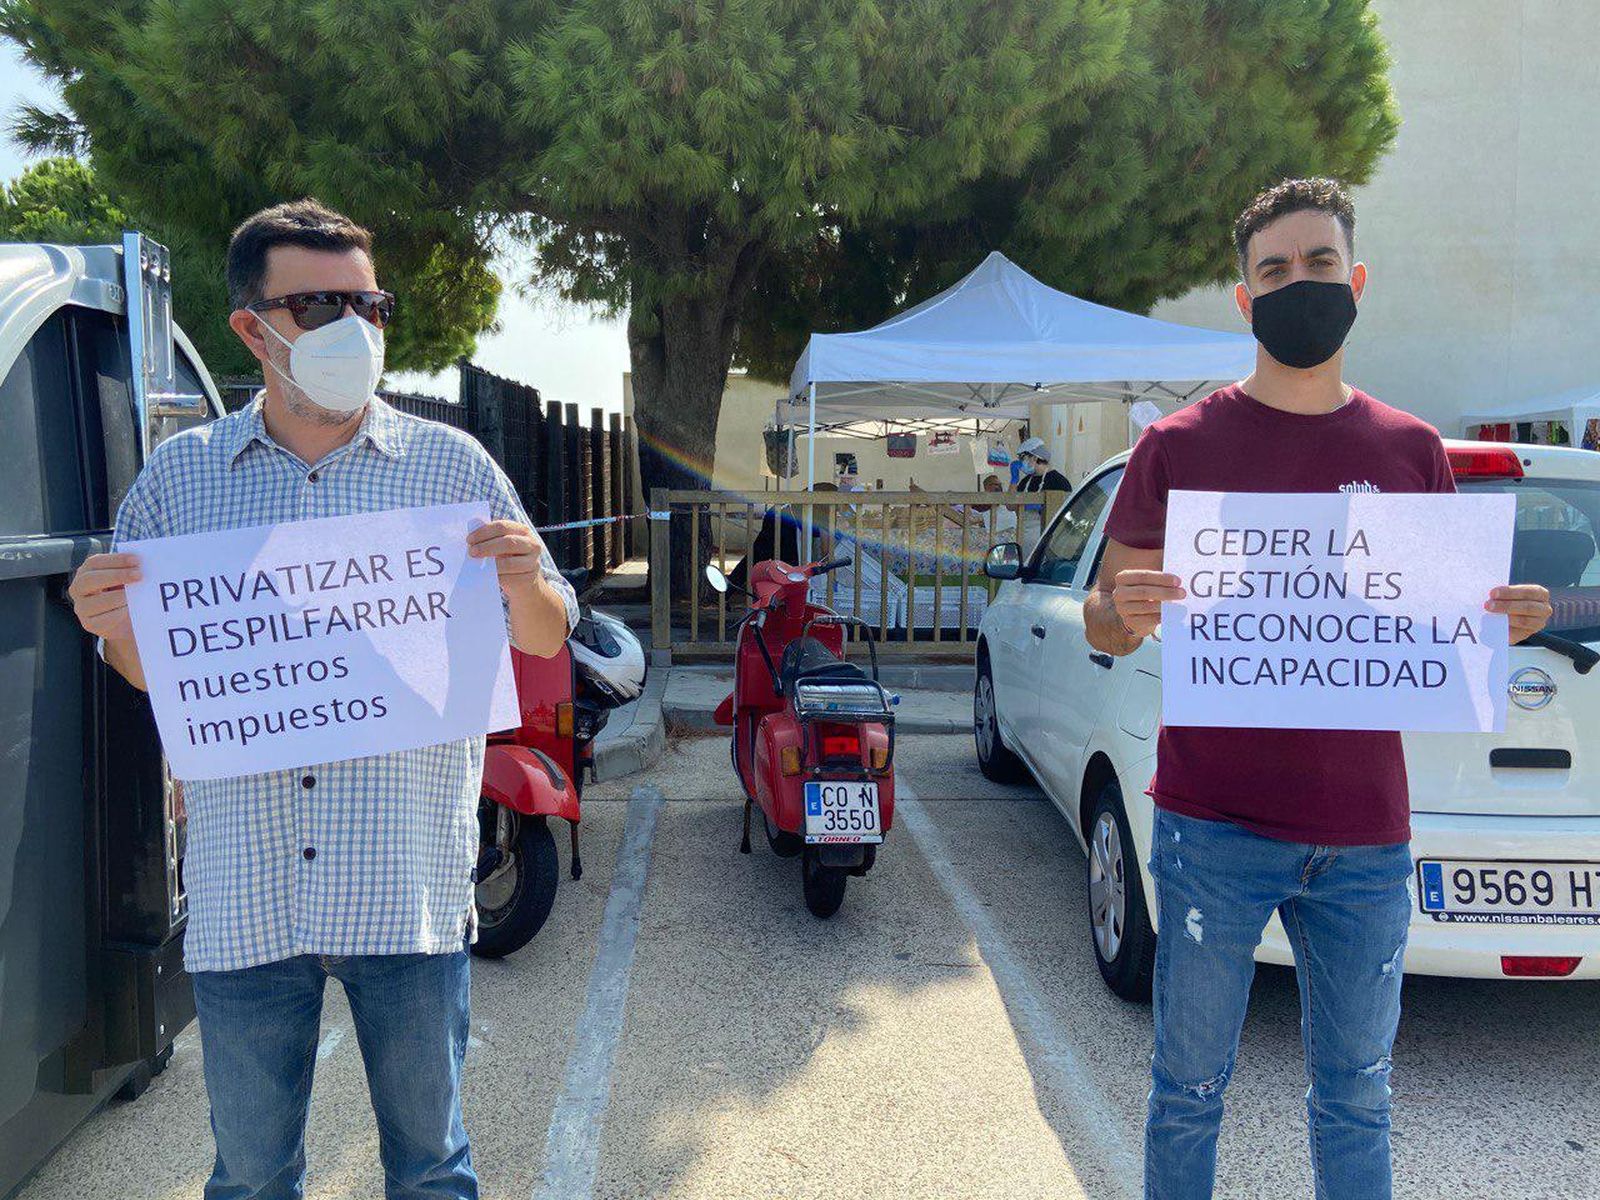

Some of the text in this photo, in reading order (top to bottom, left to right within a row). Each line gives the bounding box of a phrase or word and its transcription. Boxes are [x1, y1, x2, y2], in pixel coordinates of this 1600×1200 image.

[1193, 527, 1371, 557] CEDER LA
[159, 545, 446, 613] PRIVATIZAR ES
[1189, 564, 1403, 601] GESTIÓN ES
[166, 590, 452, 659] DESPILFARRAR
[1190, 612, 1478, 645] RECONOCER LA
[178, 655, 350, 703] nuestros
[1191, 656, 1448, 689] INCAPACIDAD
[1512, 684, 1553, 693] NISSAN
[186, 694, 389, 747] impuestos
[811, 801, 818, 810] E
[821, 786, 874, 808] CO N
[823, 809, 876, 831] 3550
[1430, 892, 1440, 902] E
[1452, 868, 1600, 908] 9569 H
